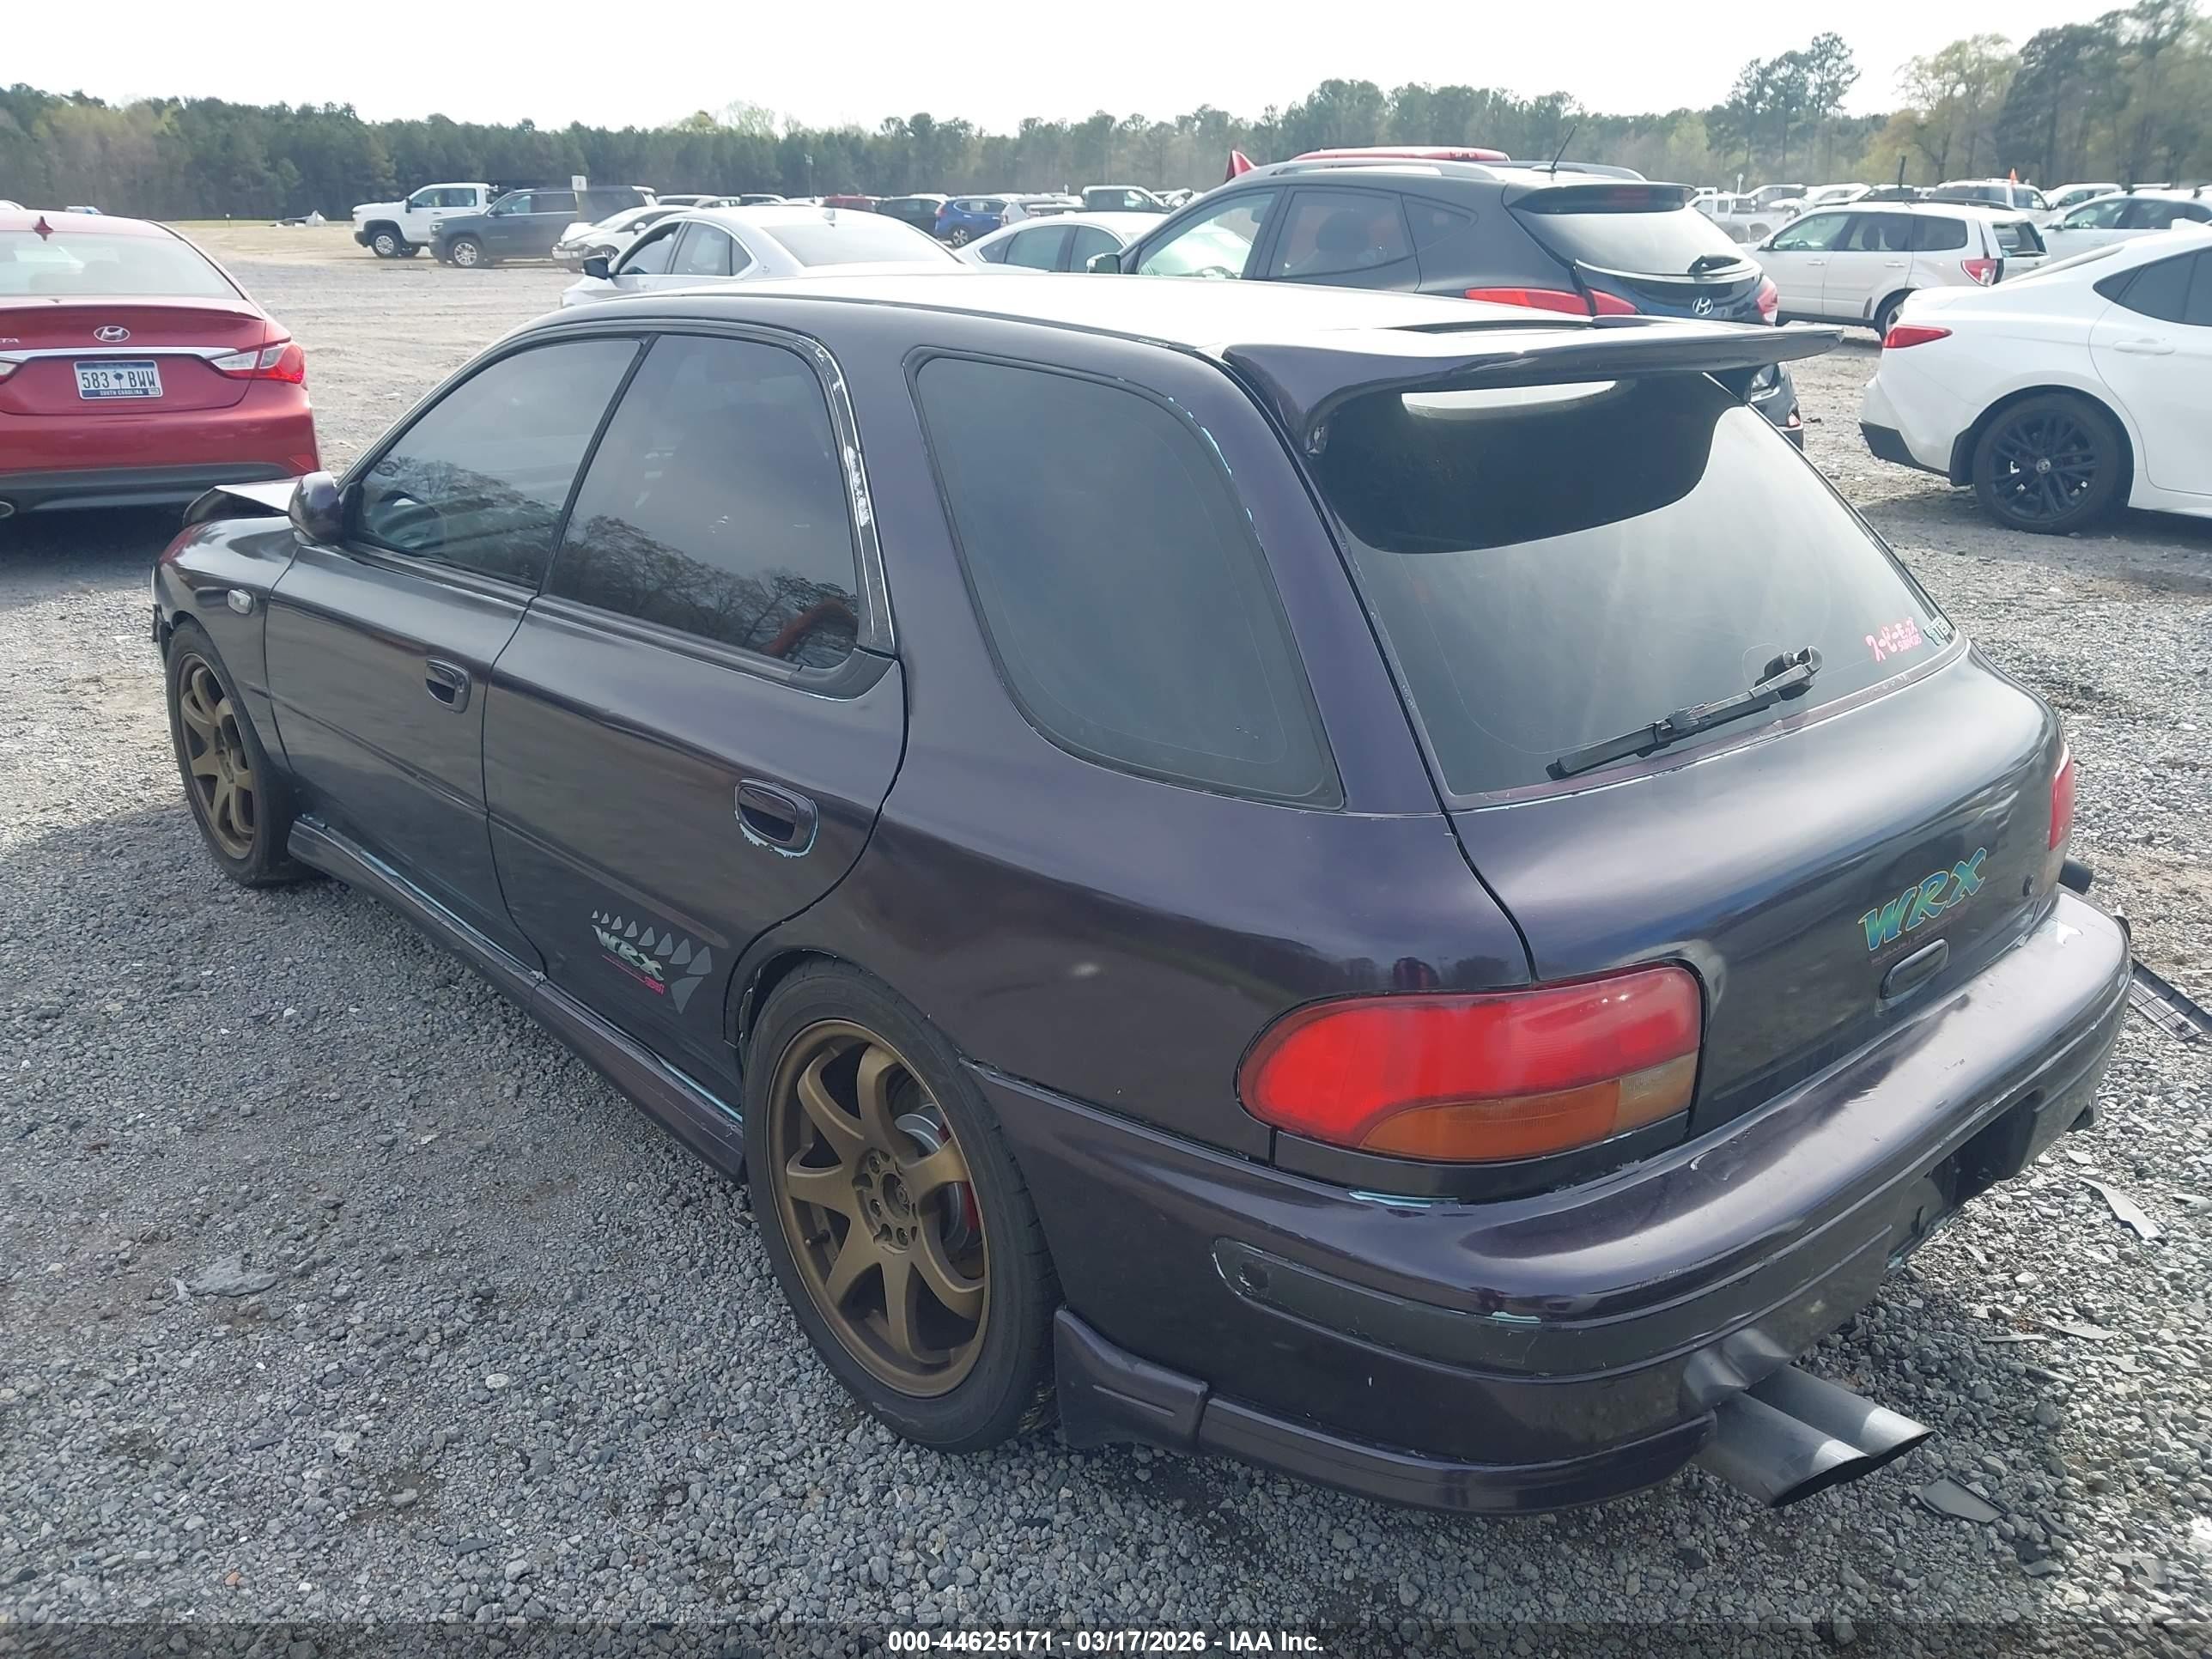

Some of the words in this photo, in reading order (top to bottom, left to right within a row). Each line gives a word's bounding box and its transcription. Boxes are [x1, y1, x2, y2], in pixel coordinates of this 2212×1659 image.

[81, 372, 109, 388] 583
[127, 370, 156, 387] BWW
[1857, 847, 1988, 952] WRX
[591, 924, 665, 981] WRX
